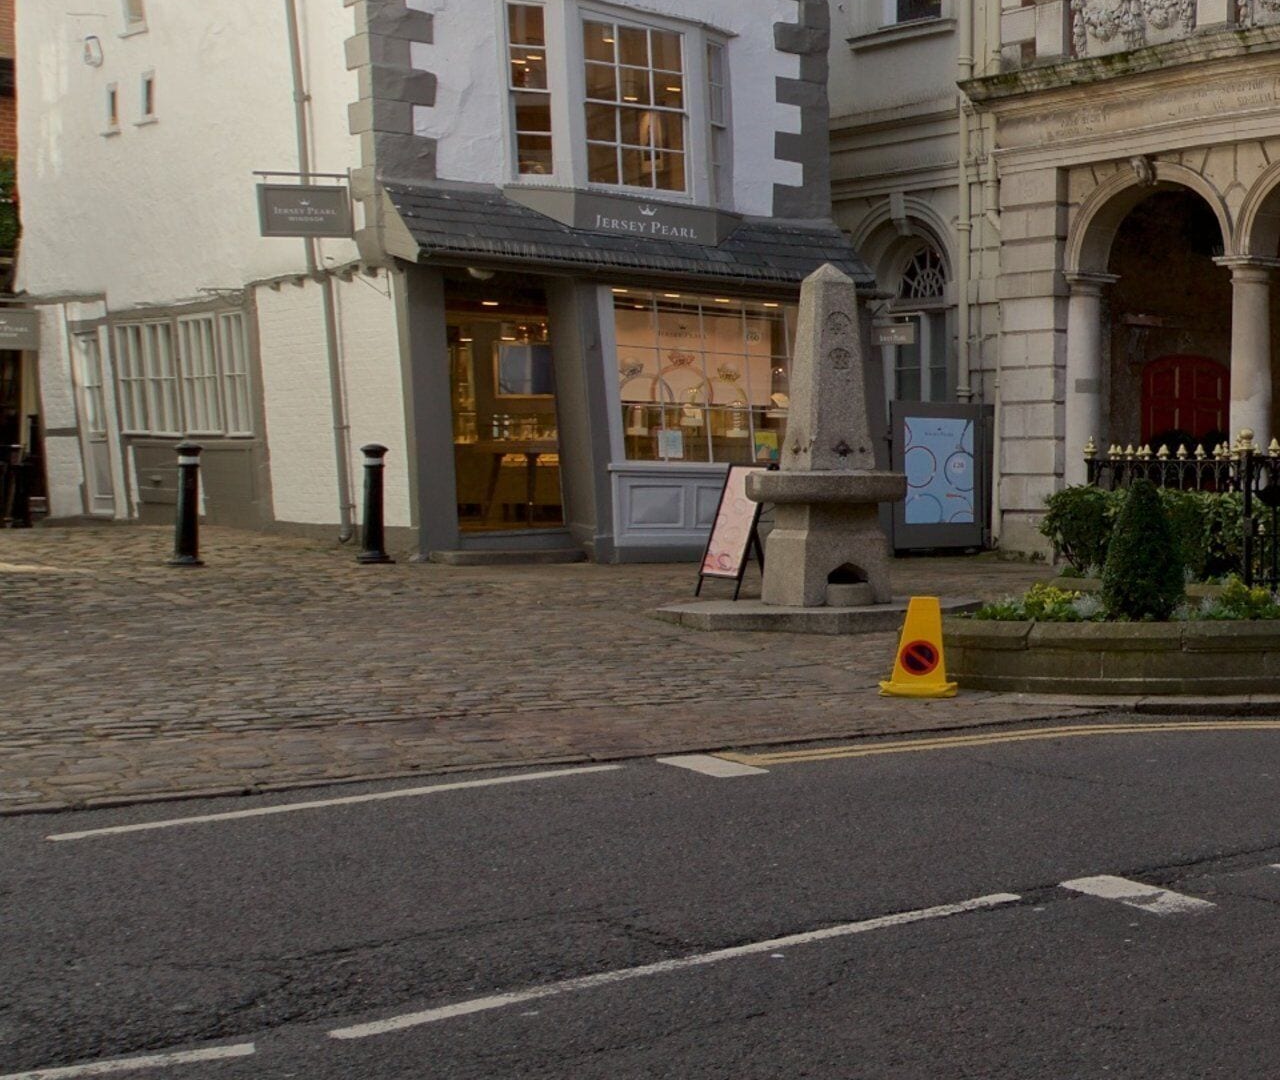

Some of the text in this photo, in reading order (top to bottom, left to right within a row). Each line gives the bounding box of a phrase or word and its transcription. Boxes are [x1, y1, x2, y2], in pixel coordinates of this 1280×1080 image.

[273, 206, 337, 215] JERSEY PEARL
[595, 214, 698, 238] JERSEY PEARL
